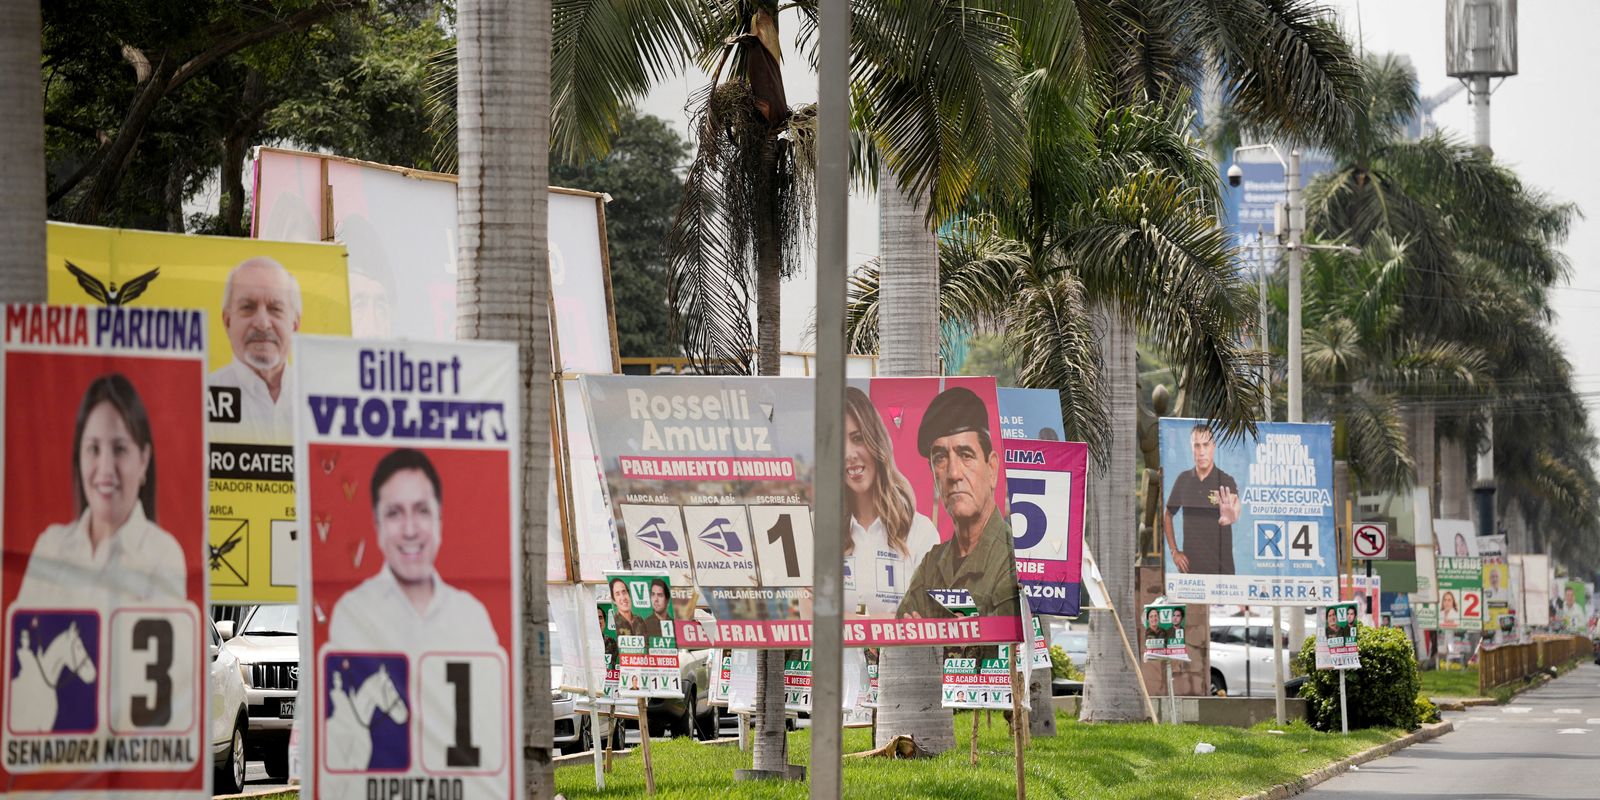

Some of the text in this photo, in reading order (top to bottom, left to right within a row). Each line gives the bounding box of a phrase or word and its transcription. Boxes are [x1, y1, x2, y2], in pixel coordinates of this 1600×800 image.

[5, 305, 203, 351] MARIA PARIONA
[359, 349, 462, 394] Gilbert
[627, 388, 750, 421] Rosselli
[1012, 416, 1024, 425] DE
[642, 420, 772, 451] Amuruz
[1006, 450, 1045, 464] LIMA
[621, 458, 793, 477] PARLAMENTO ANDINO
[626, 494, 653, 503] MARCA
[690, 496, 719, 504] MARCA
[756, 495, 786, 504] ESCRIBE
[1243, 489, 1330, 504] ALEX SEGURA
[1007, 478, 1048, 550] 5
[1252, 506, 1288, 514] DIPUTADO
[767, 513, 800, 578] 1
[1257, 523, 1313, 557] R 4
[633, 559, 689, 569] AVANZA PAÍS
[697, 560, 753, 570] AVANZA PAÍS
[1450, 558, 1481, 570] VERDE
[885, 565, 894, 587] 1
[632, 584, 646, 600] V
[1168, 582, 1175, 591] R
[1249, 585, 1332, 598] R R R R 4 R
[713, 590, 811, 600] PARLAMENTO ANDINO
[1464, 593, 1480, 617] 2
[1162, 611, 1170, 619] V
[664, 622, 672, 637] 1
[871, 620, 981, 641] PRESIDENTE
[620, 637, 672, 648] ALEX LAY
[621, 656, 629, 665] SE
[649, 657, 656, 666] EL
[946, 660, 1008, 668] ALEX LAY
[131, 619, 174, 728] 3
[955, 675, 978, 684] ACABÓ
[651, 677, 658, 690] 1
[672, 678, 679, 690] 1
[802, 694, 809, 704] 1
[968, 692, 977, 700] V
[981, 692, 988, 702] 1
[992, 692, 1000, 701] V
[445, 662, 480, 767] 1
[7, 735, 193, 765] SENADORA NACIONAL
